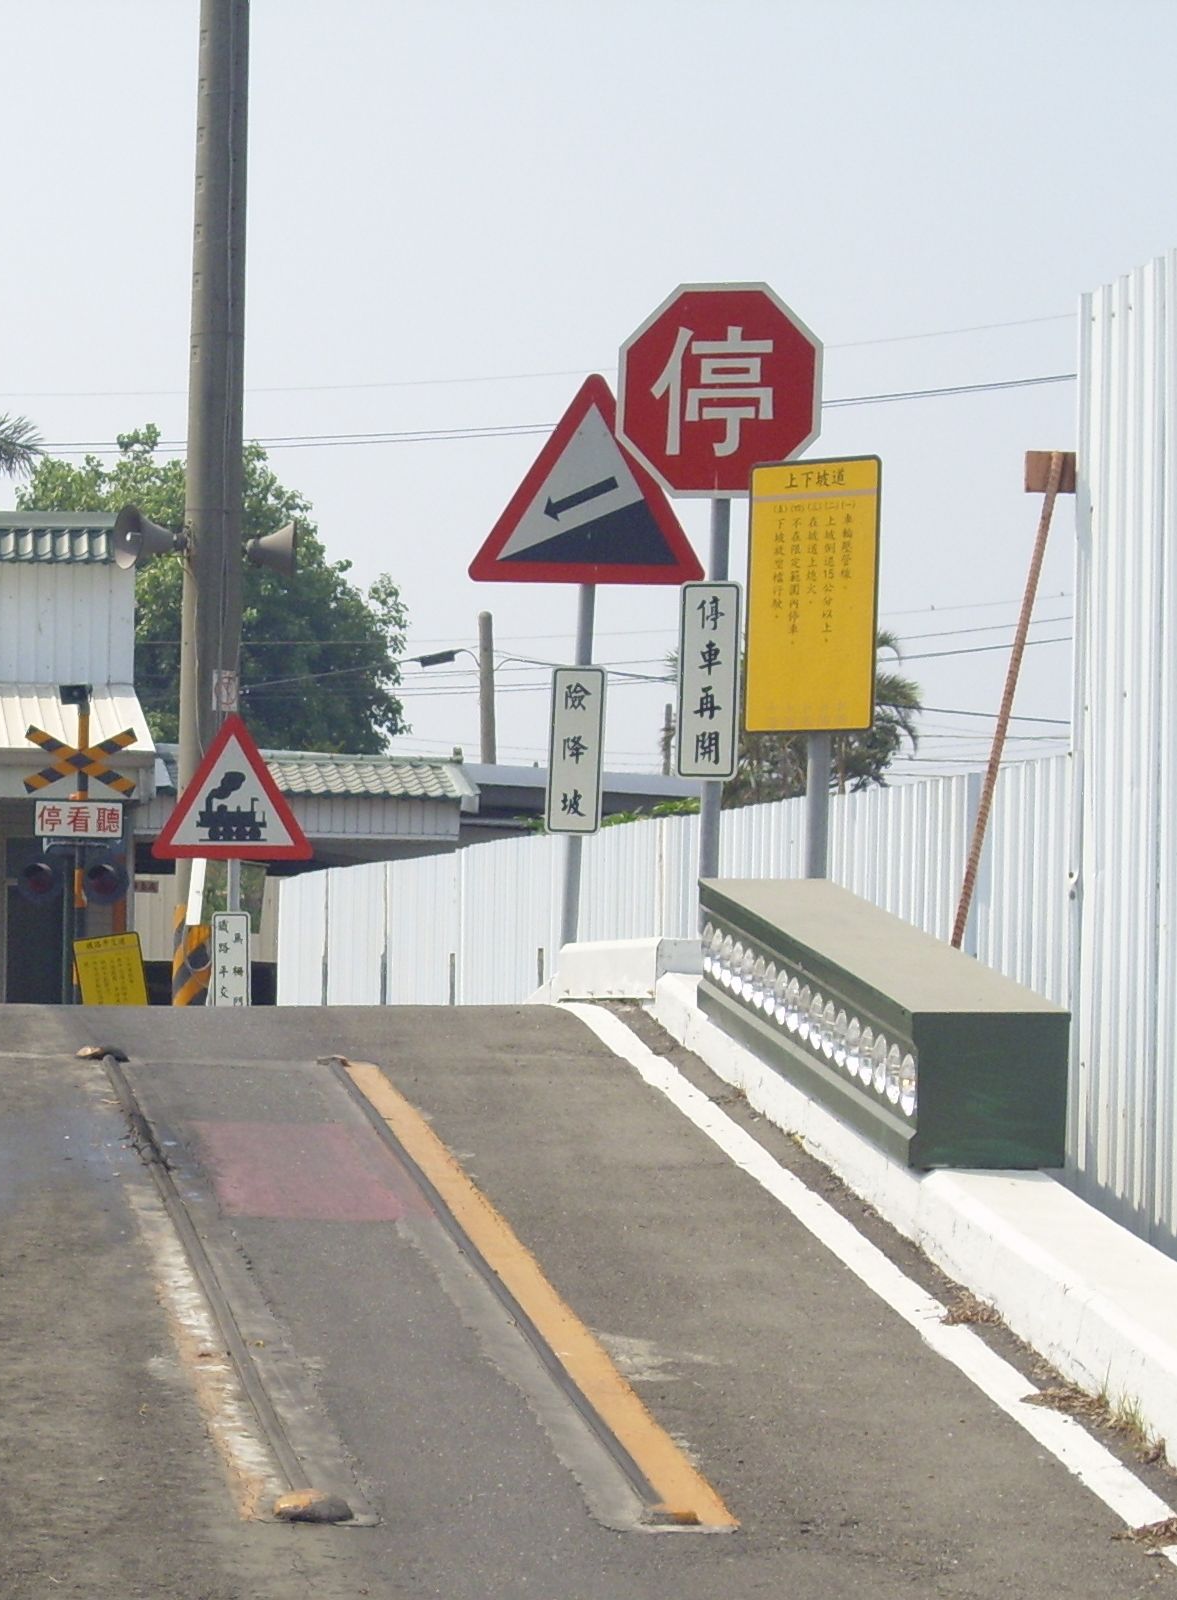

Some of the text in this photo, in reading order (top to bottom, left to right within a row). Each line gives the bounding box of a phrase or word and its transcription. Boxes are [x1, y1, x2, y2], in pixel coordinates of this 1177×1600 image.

[650, 326, 773, 457] 停
[785, 468, 845, 489] 上下坡道
[693, 596, 725, 765] 停車再開
[561, 683, 592, 817] 險降坡
[38, 804, 120, 833] 停看聽
